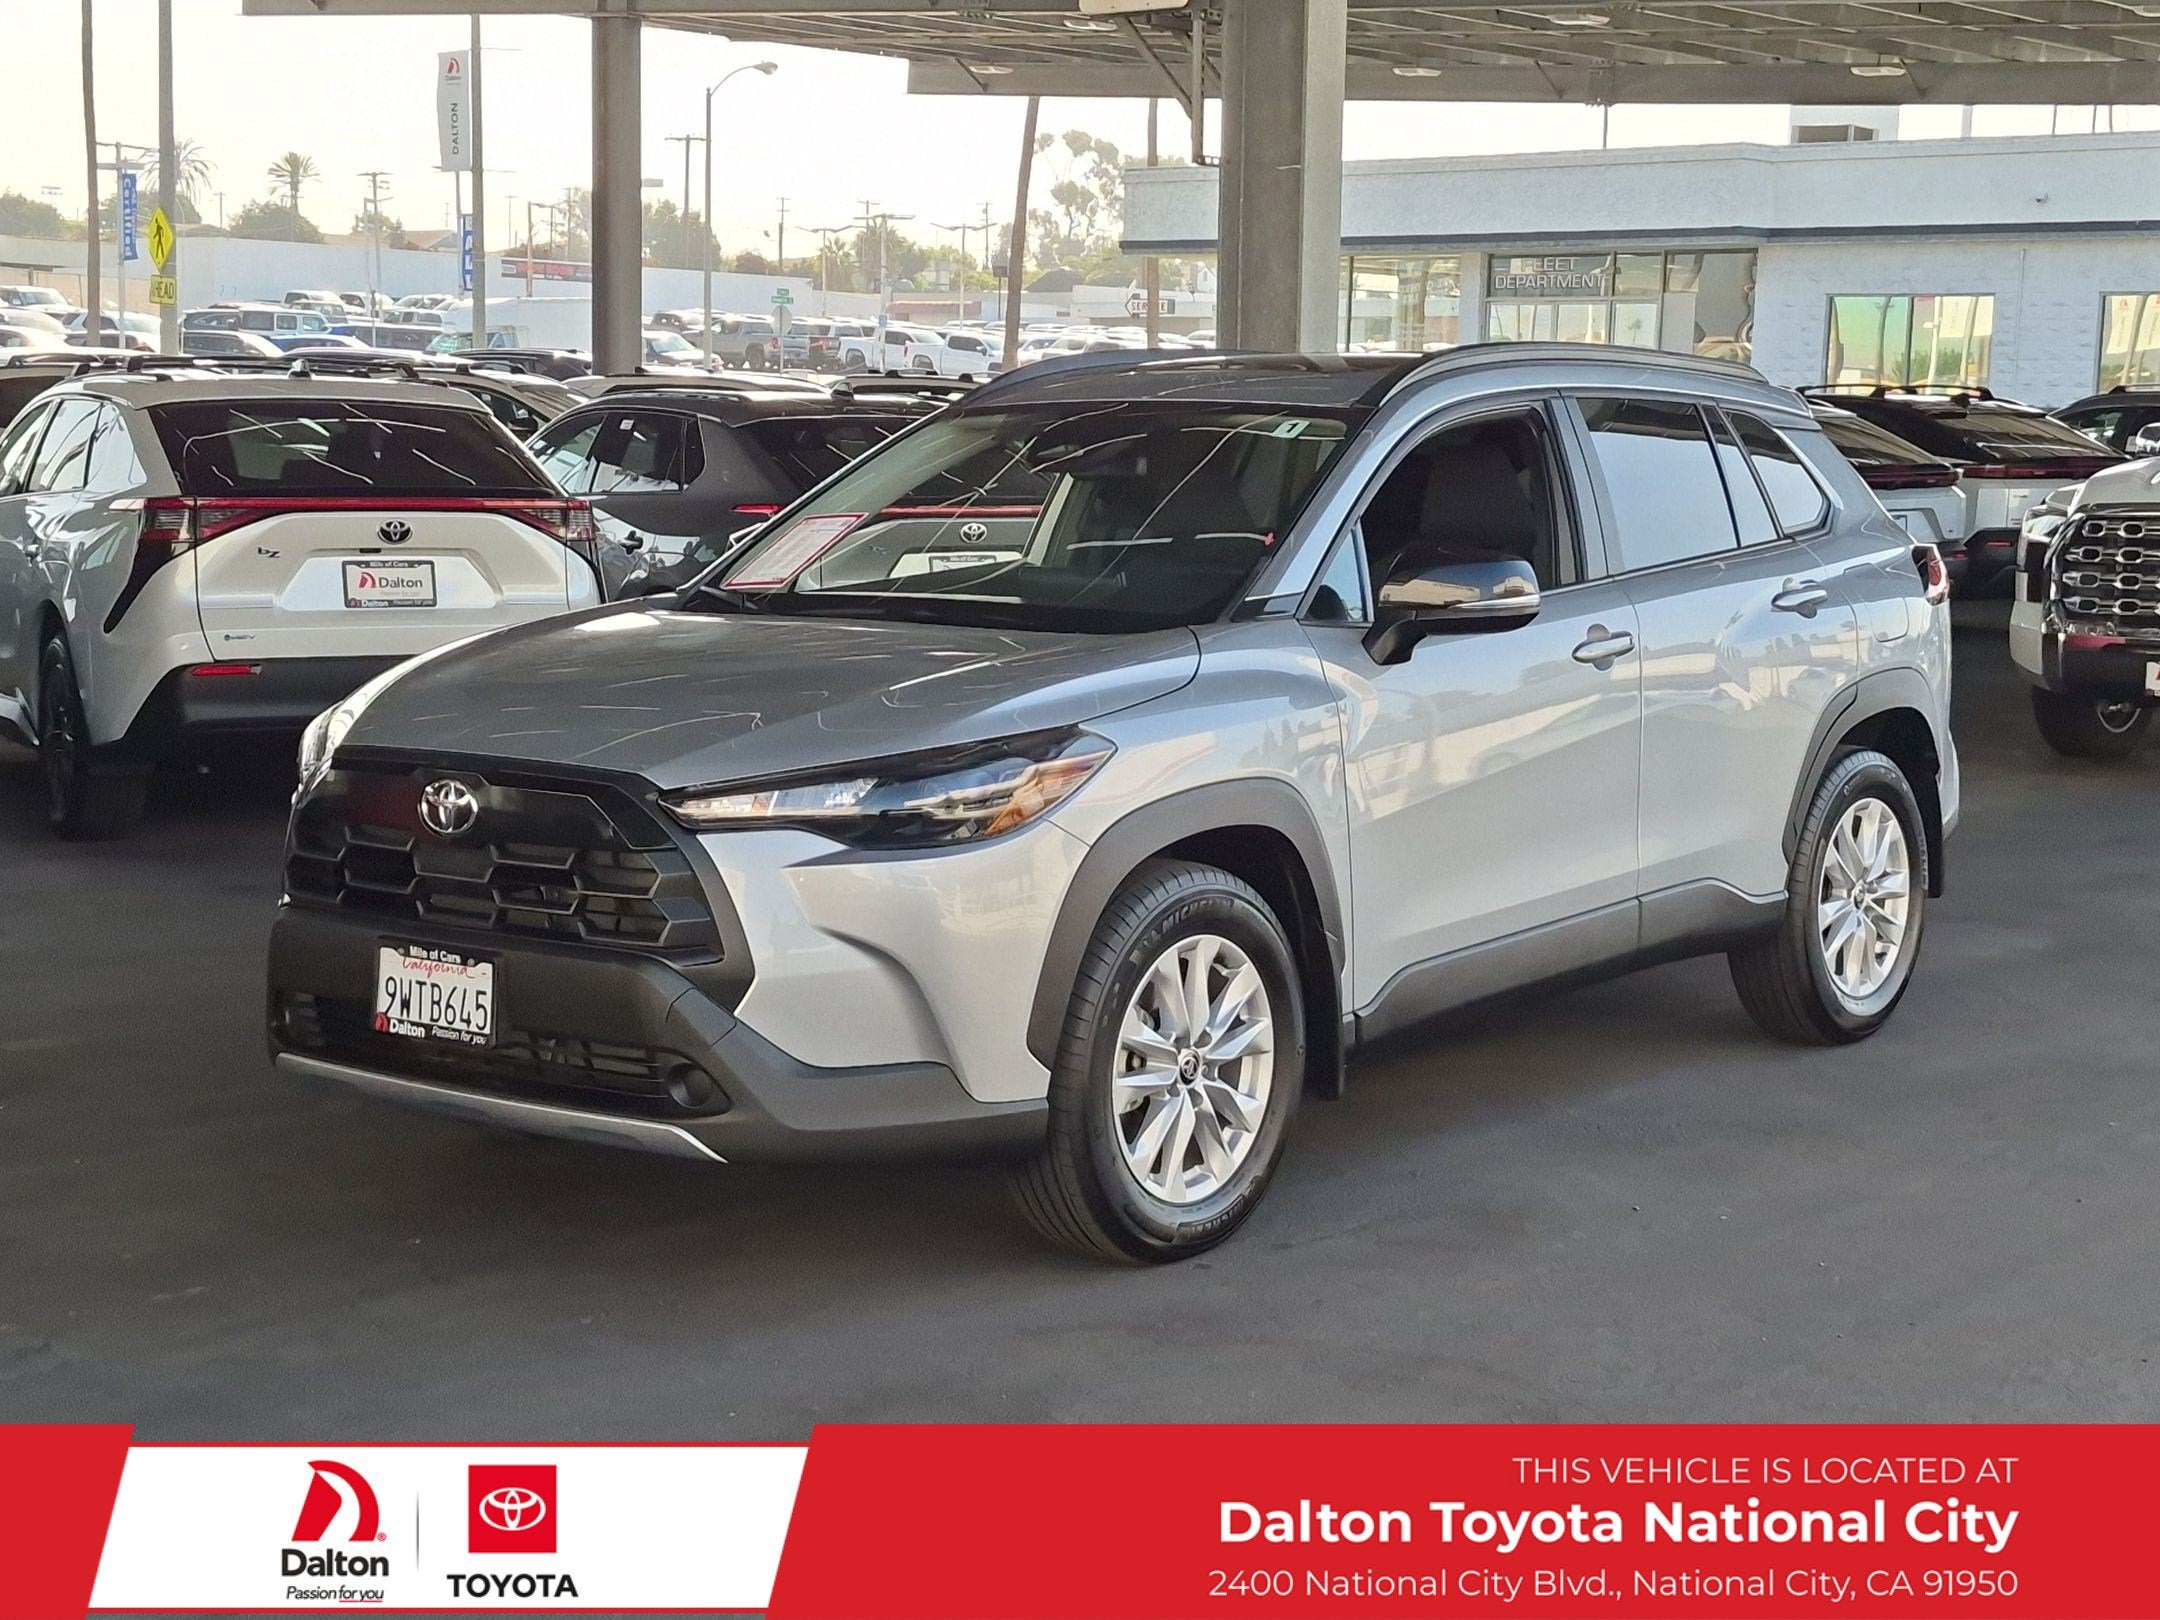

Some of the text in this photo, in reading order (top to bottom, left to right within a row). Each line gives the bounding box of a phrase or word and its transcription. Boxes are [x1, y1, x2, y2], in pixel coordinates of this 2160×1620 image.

[450, 102, 459, 155] DALTON
[152, 281, 174, 299] HEAD
[1495, 273, 1607, 289] DEPARTMENT
[1131, 302, 1166, 311] SERE
[378, 576, 423, 588] Dalton
[409, 945, 461, 964] Mile of Cars
[384, 976, 488, 1031] 9WTB645
[389, 1018, 487, 1045] Dalton Passion for you
